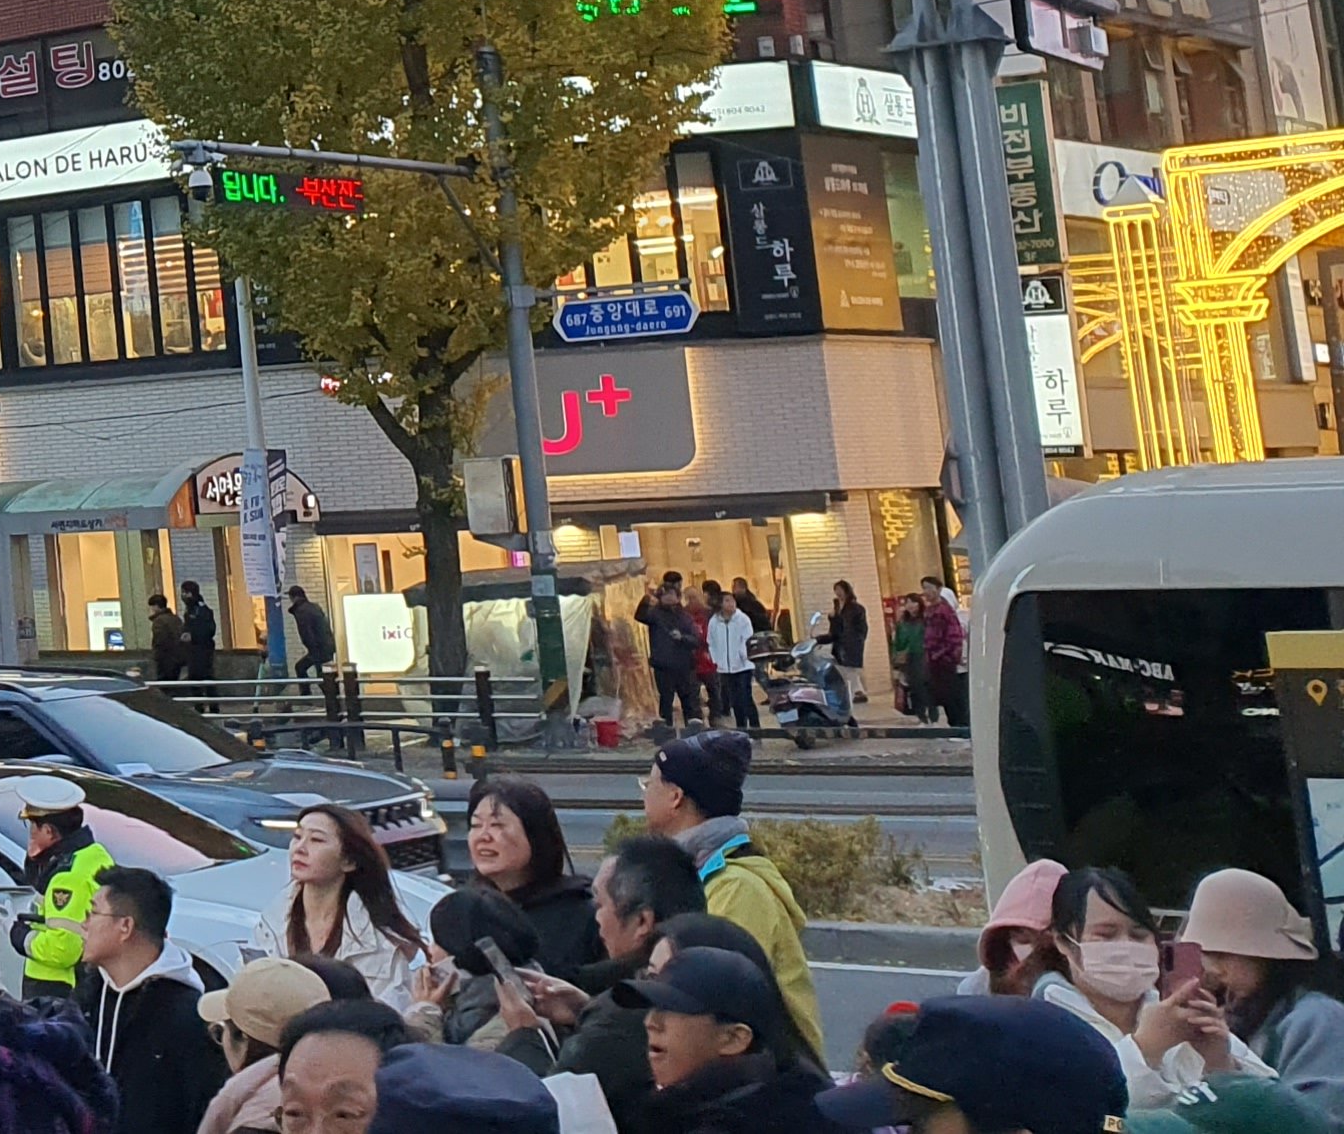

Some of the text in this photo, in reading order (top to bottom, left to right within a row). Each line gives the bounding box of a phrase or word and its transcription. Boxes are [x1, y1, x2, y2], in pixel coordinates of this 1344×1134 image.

[56, 154, 82, 175] DE
[89, 143, 149, 171] HARU
[999, 102, 1043, 236] 비전부동산
[222, 170, 287, 204] 됩니다.
[771, 237, 797, 289] 하루
[565, 298, 687, 328] 687 중앙대로 691
[585, 319, 668, 336] Jungang-daero
[1045, 367, 1072, 425] 하루
